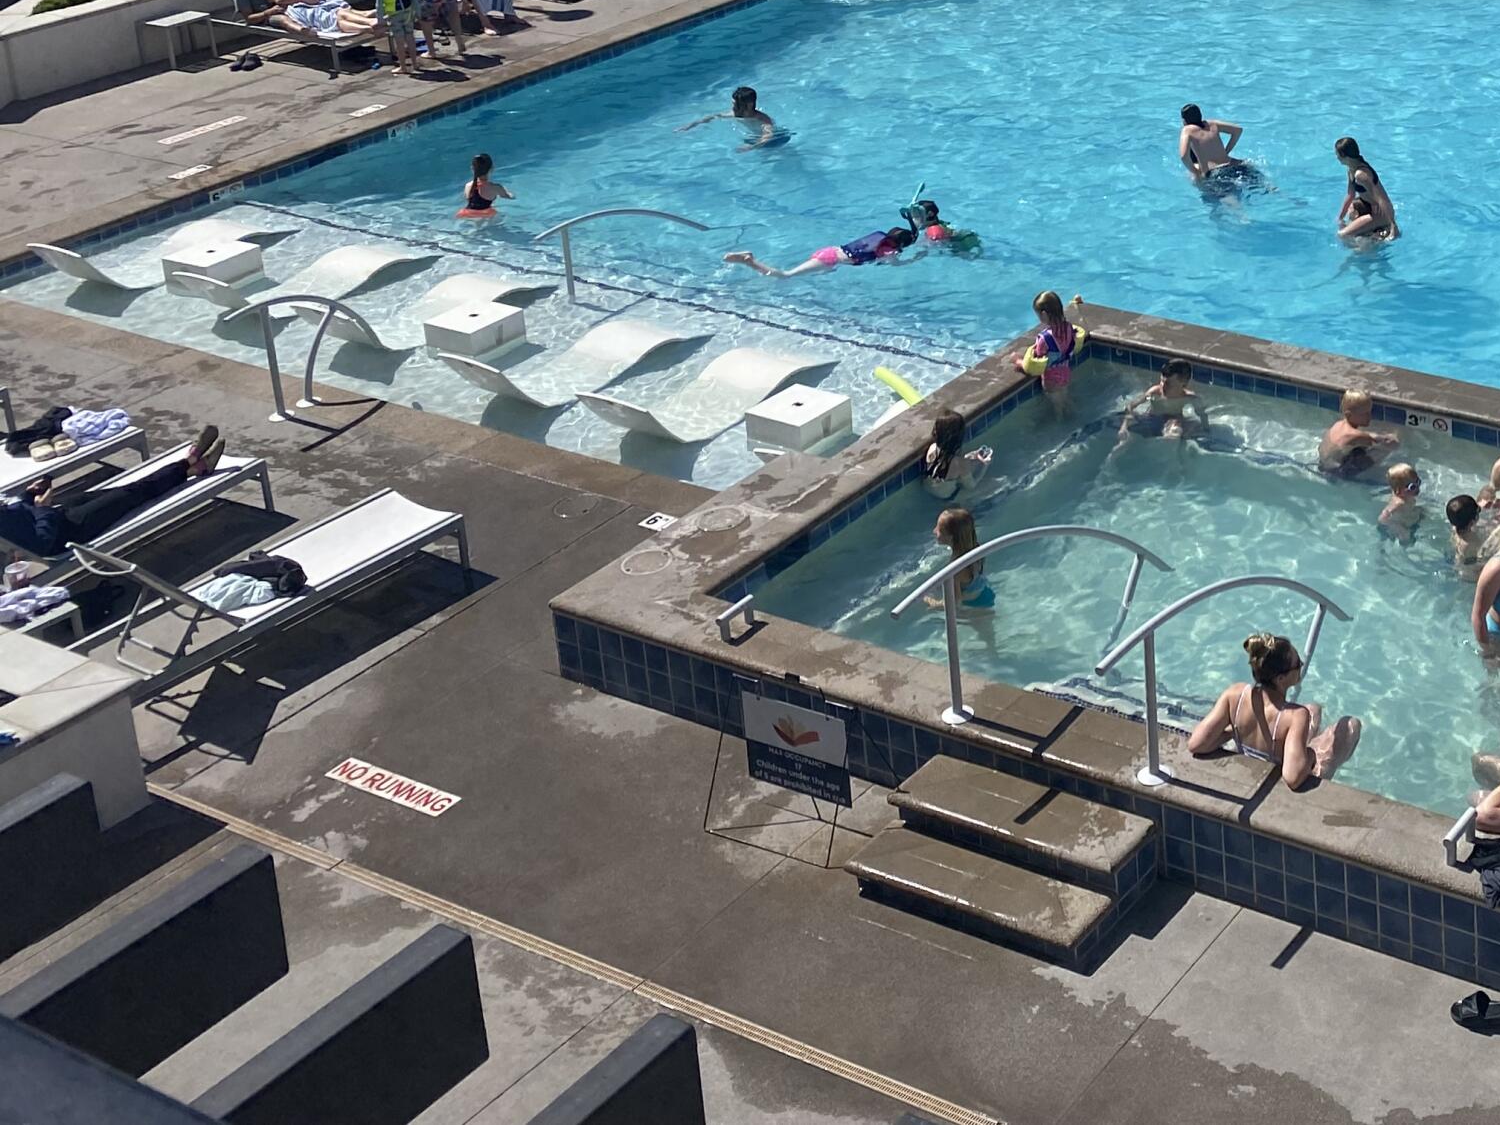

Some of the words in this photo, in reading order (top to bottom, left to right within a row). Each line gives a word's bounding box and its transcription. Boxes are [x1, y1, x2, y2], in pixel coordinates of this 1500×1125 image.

[1408, 414, 1419, 426] 3
[646, 515, 663, 525] 6
[769, 746, 783, 756] MAX
[784, 751, 826, 769] OCCUPANCY
[756, 759, 787, 775] Children
[789, 769, 810, 781] under
[811, 776, 824, 786] the
[826, 781, 840, 791] age
[332, 761, 368, 780] NO
[362, 772, 452, 812] RUNNING
[784, 780, 822, 797] prohibited
